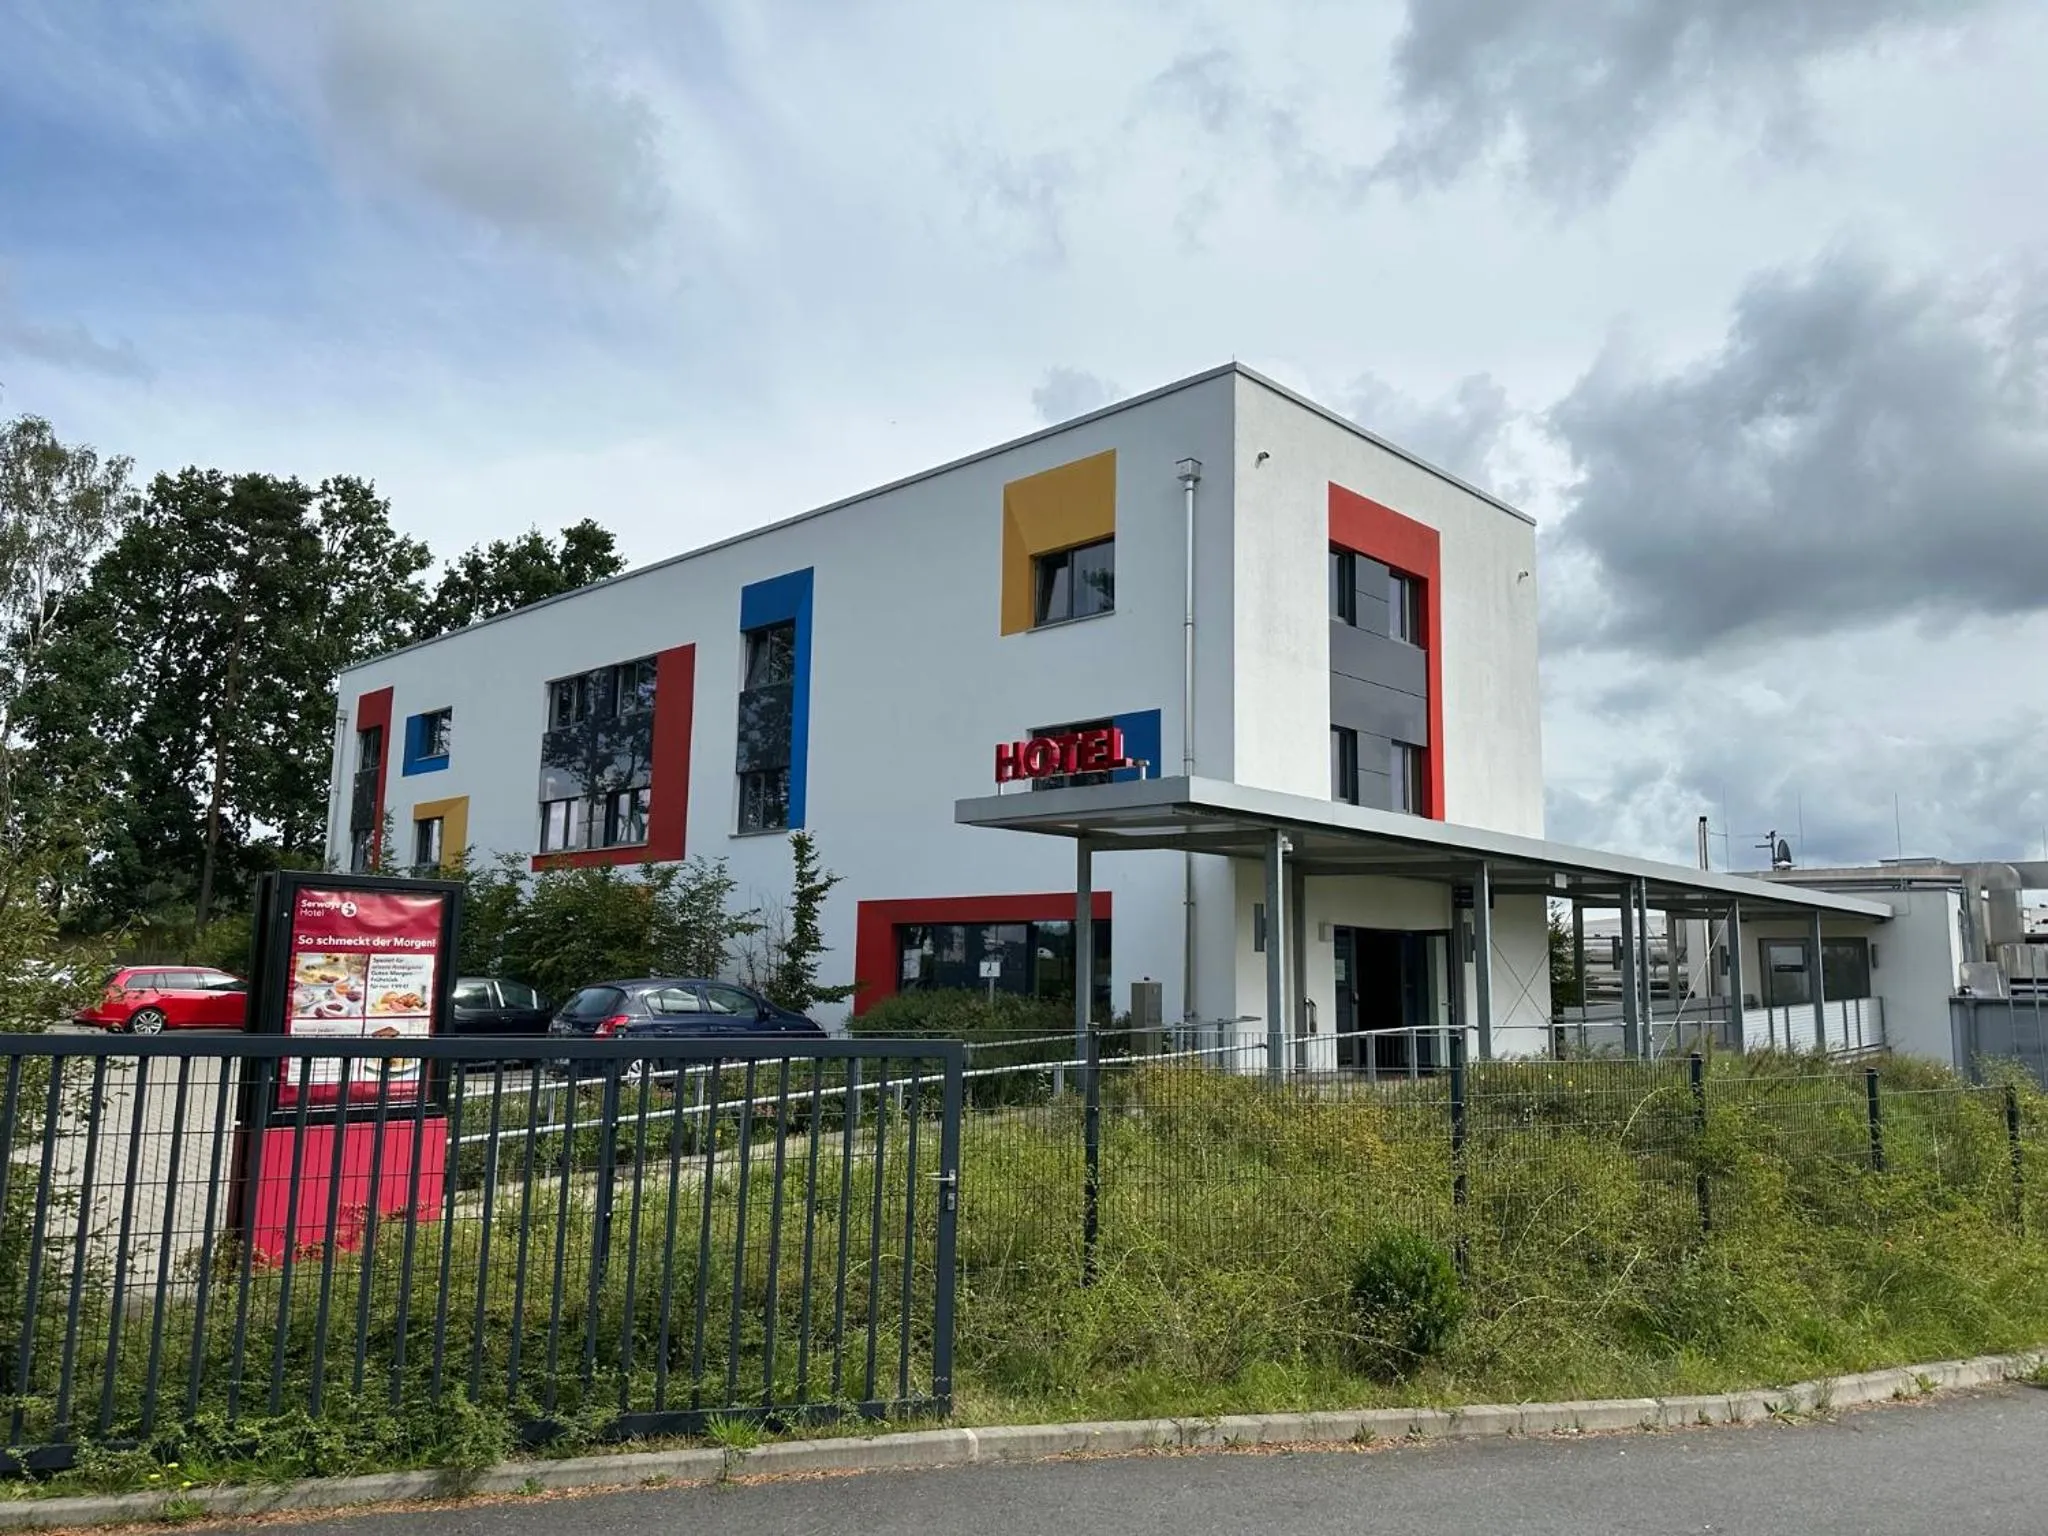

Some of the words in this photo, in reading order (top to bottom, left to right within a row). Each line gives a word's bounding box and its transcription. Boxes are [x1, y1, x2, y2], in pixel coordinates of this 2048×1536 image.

[996, 728, 1128, 783] HOTEL
[301, 900, 340, 910] Serways
[300, 908, 325, 917] Hotel
[298, 935, 313, 945] So
[316, 935, 370, 946] schmeckt
[372, 936, 391, 947] der
[393, 937, 436, 949] Morgen!
